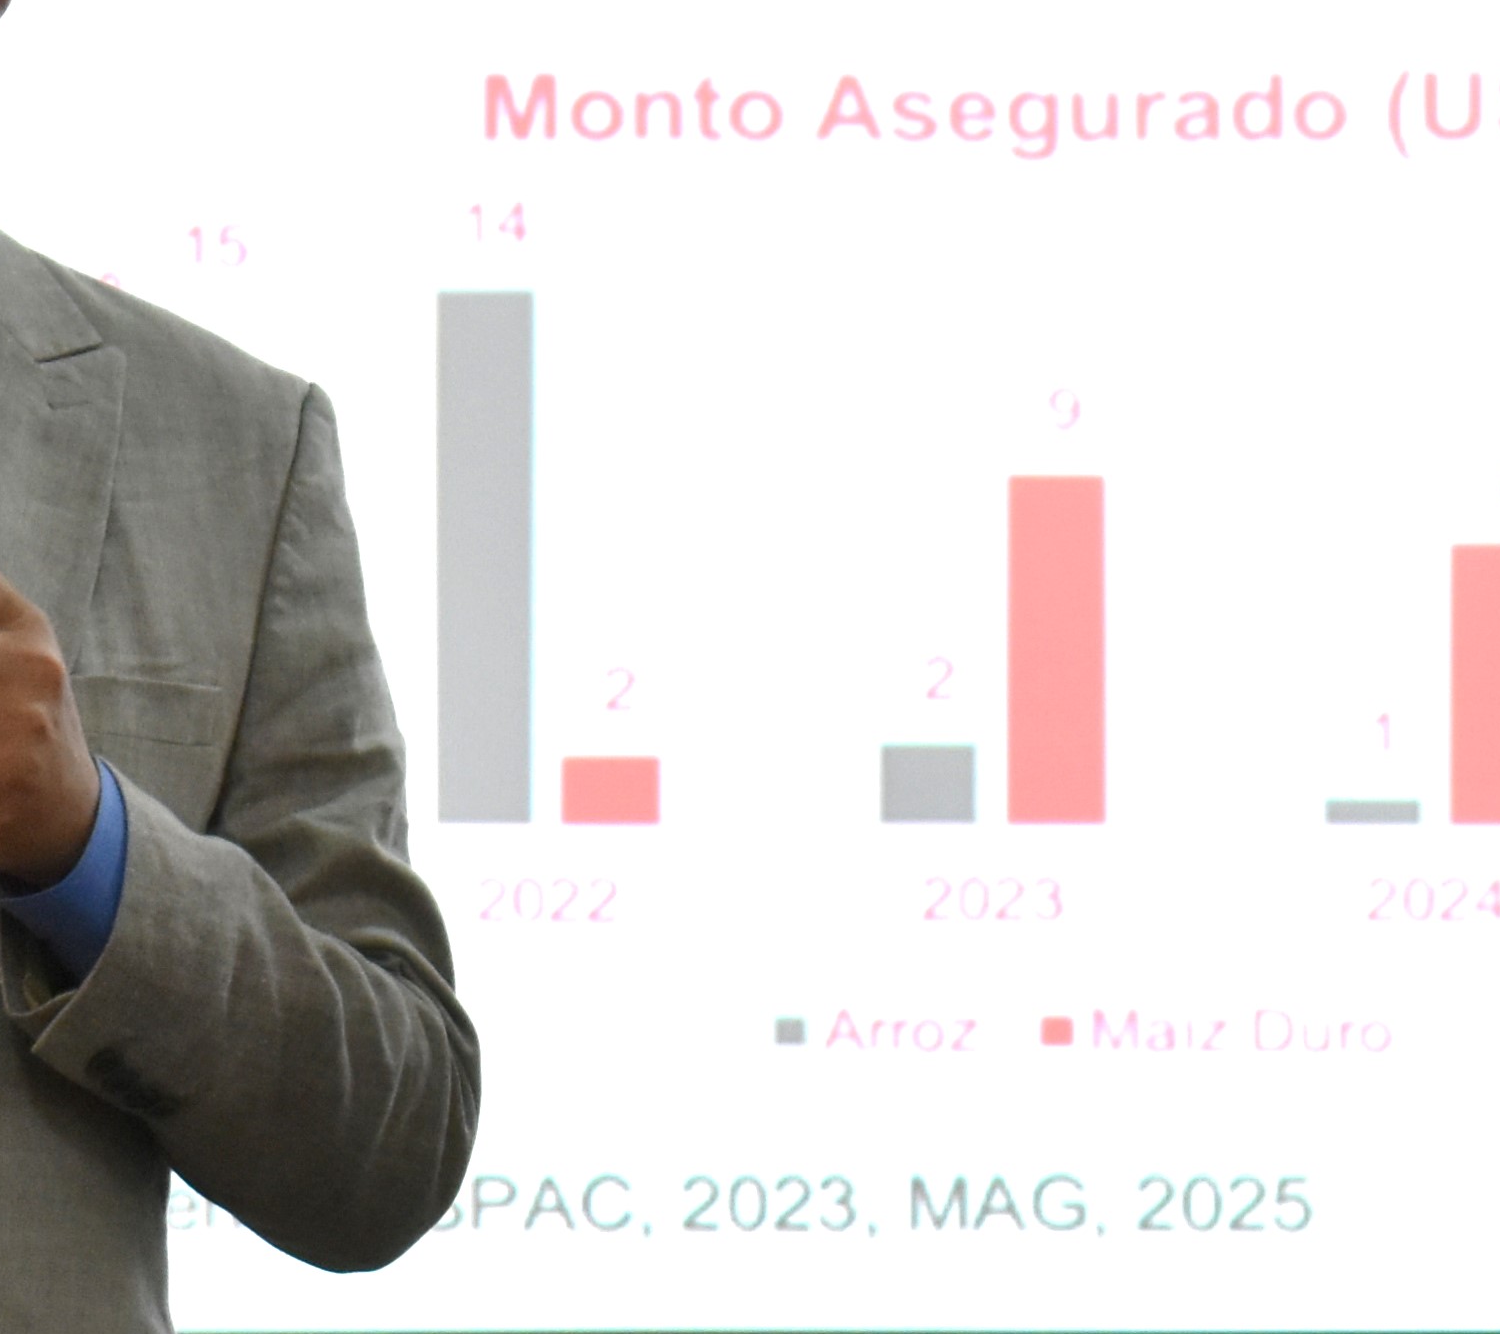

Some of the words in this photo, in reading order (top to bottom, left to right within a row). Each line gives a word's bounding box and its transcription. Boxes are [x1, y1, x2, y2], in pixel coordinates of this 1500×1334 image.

[484, 73, 784, 142] Monto
[816, 74, 1347, 160] Asegurado
[470, 202, 527, 241] 14
[188, 225, 248, 264] 15
[1049, 389, 1081, 430] 9
[606, 670, 636, 711] 2
[926, 656, 954, 700] 2
[1376, 713, 1390, 749] 1
[479, 879, 617, 923] 2022
[923, 877, 1064, 921] 2023
[825, 1009, 977, 1052] Arroz
[1253, 1009, 1392, 1053] Duro
[433, 1170, 656, 1239] PAC,
[682, 1173, 878, 1237] 2023,
[910, 1172, 1106, 1236] MAG,
[1137, 1173, 1313, 1232] 2025
